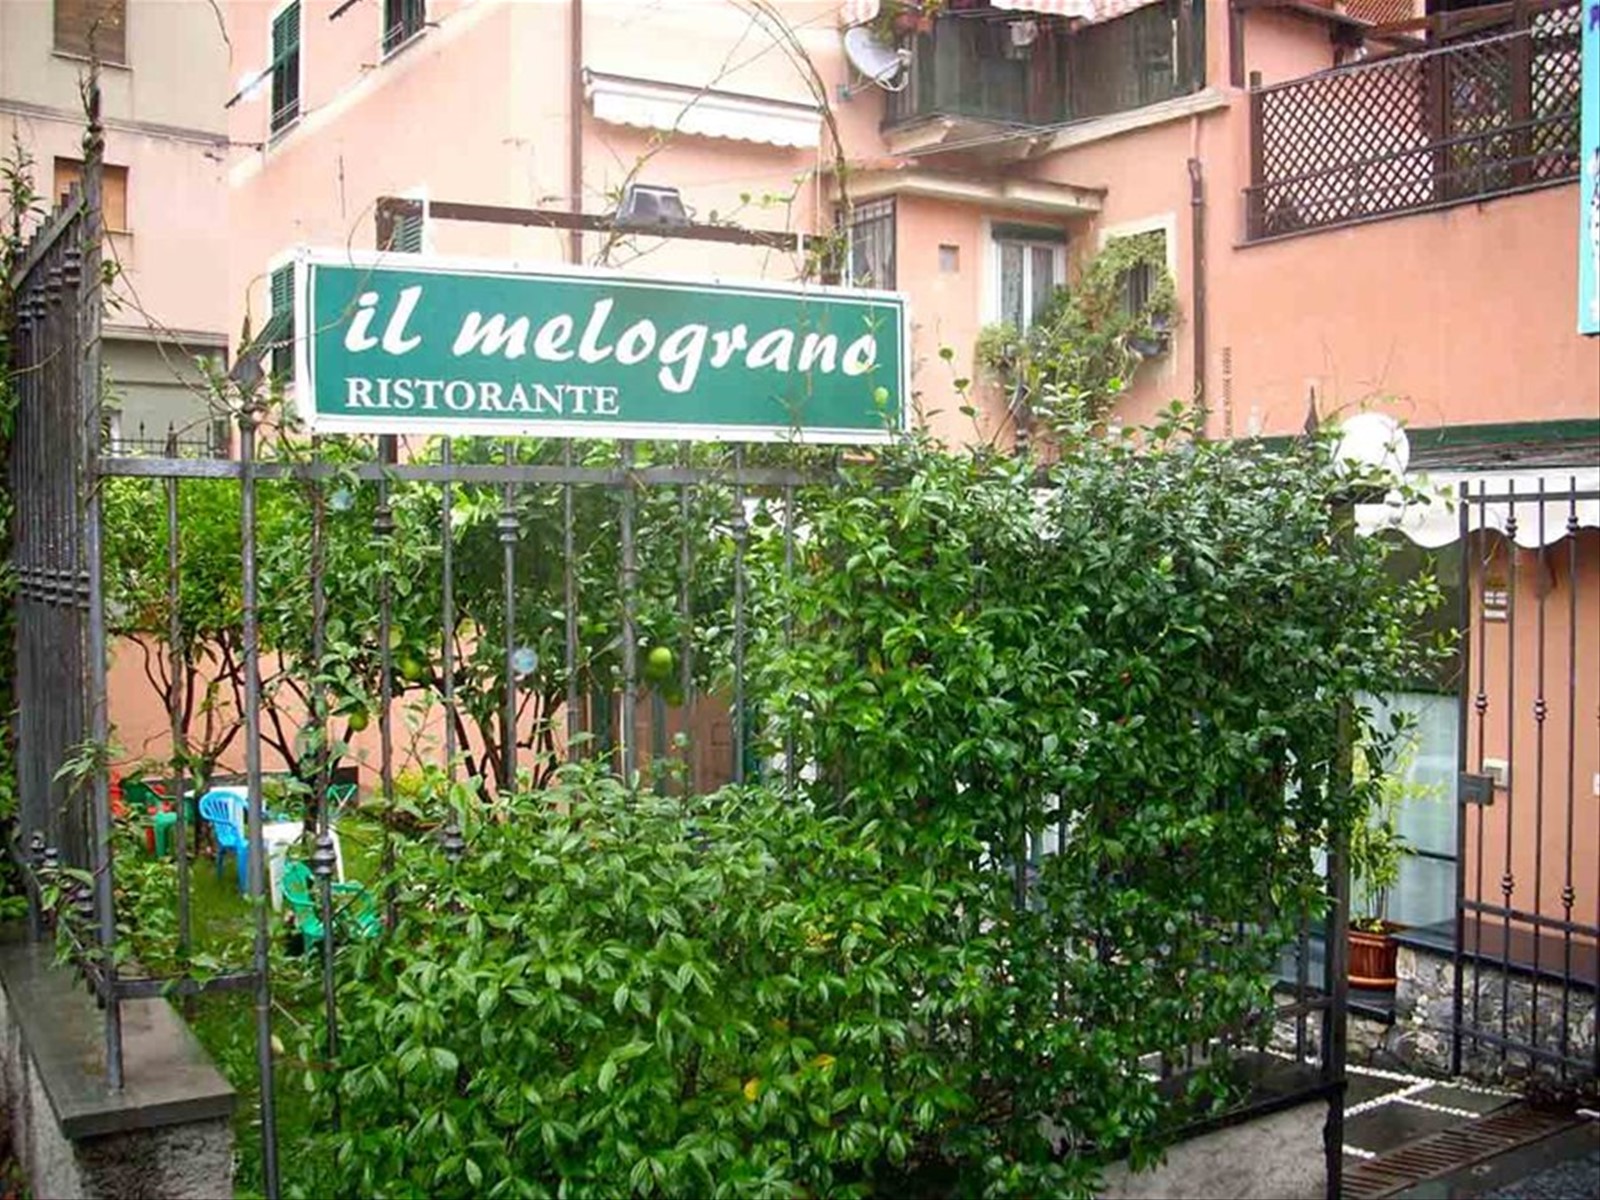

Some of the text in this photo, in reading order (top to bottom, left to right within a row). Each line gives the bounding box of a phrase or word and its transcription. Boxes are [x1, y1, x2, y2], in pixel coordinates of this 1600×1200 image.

[344, 286, 878, 393] il melograno
[345, 377, 620, 416] RISTORANTE
